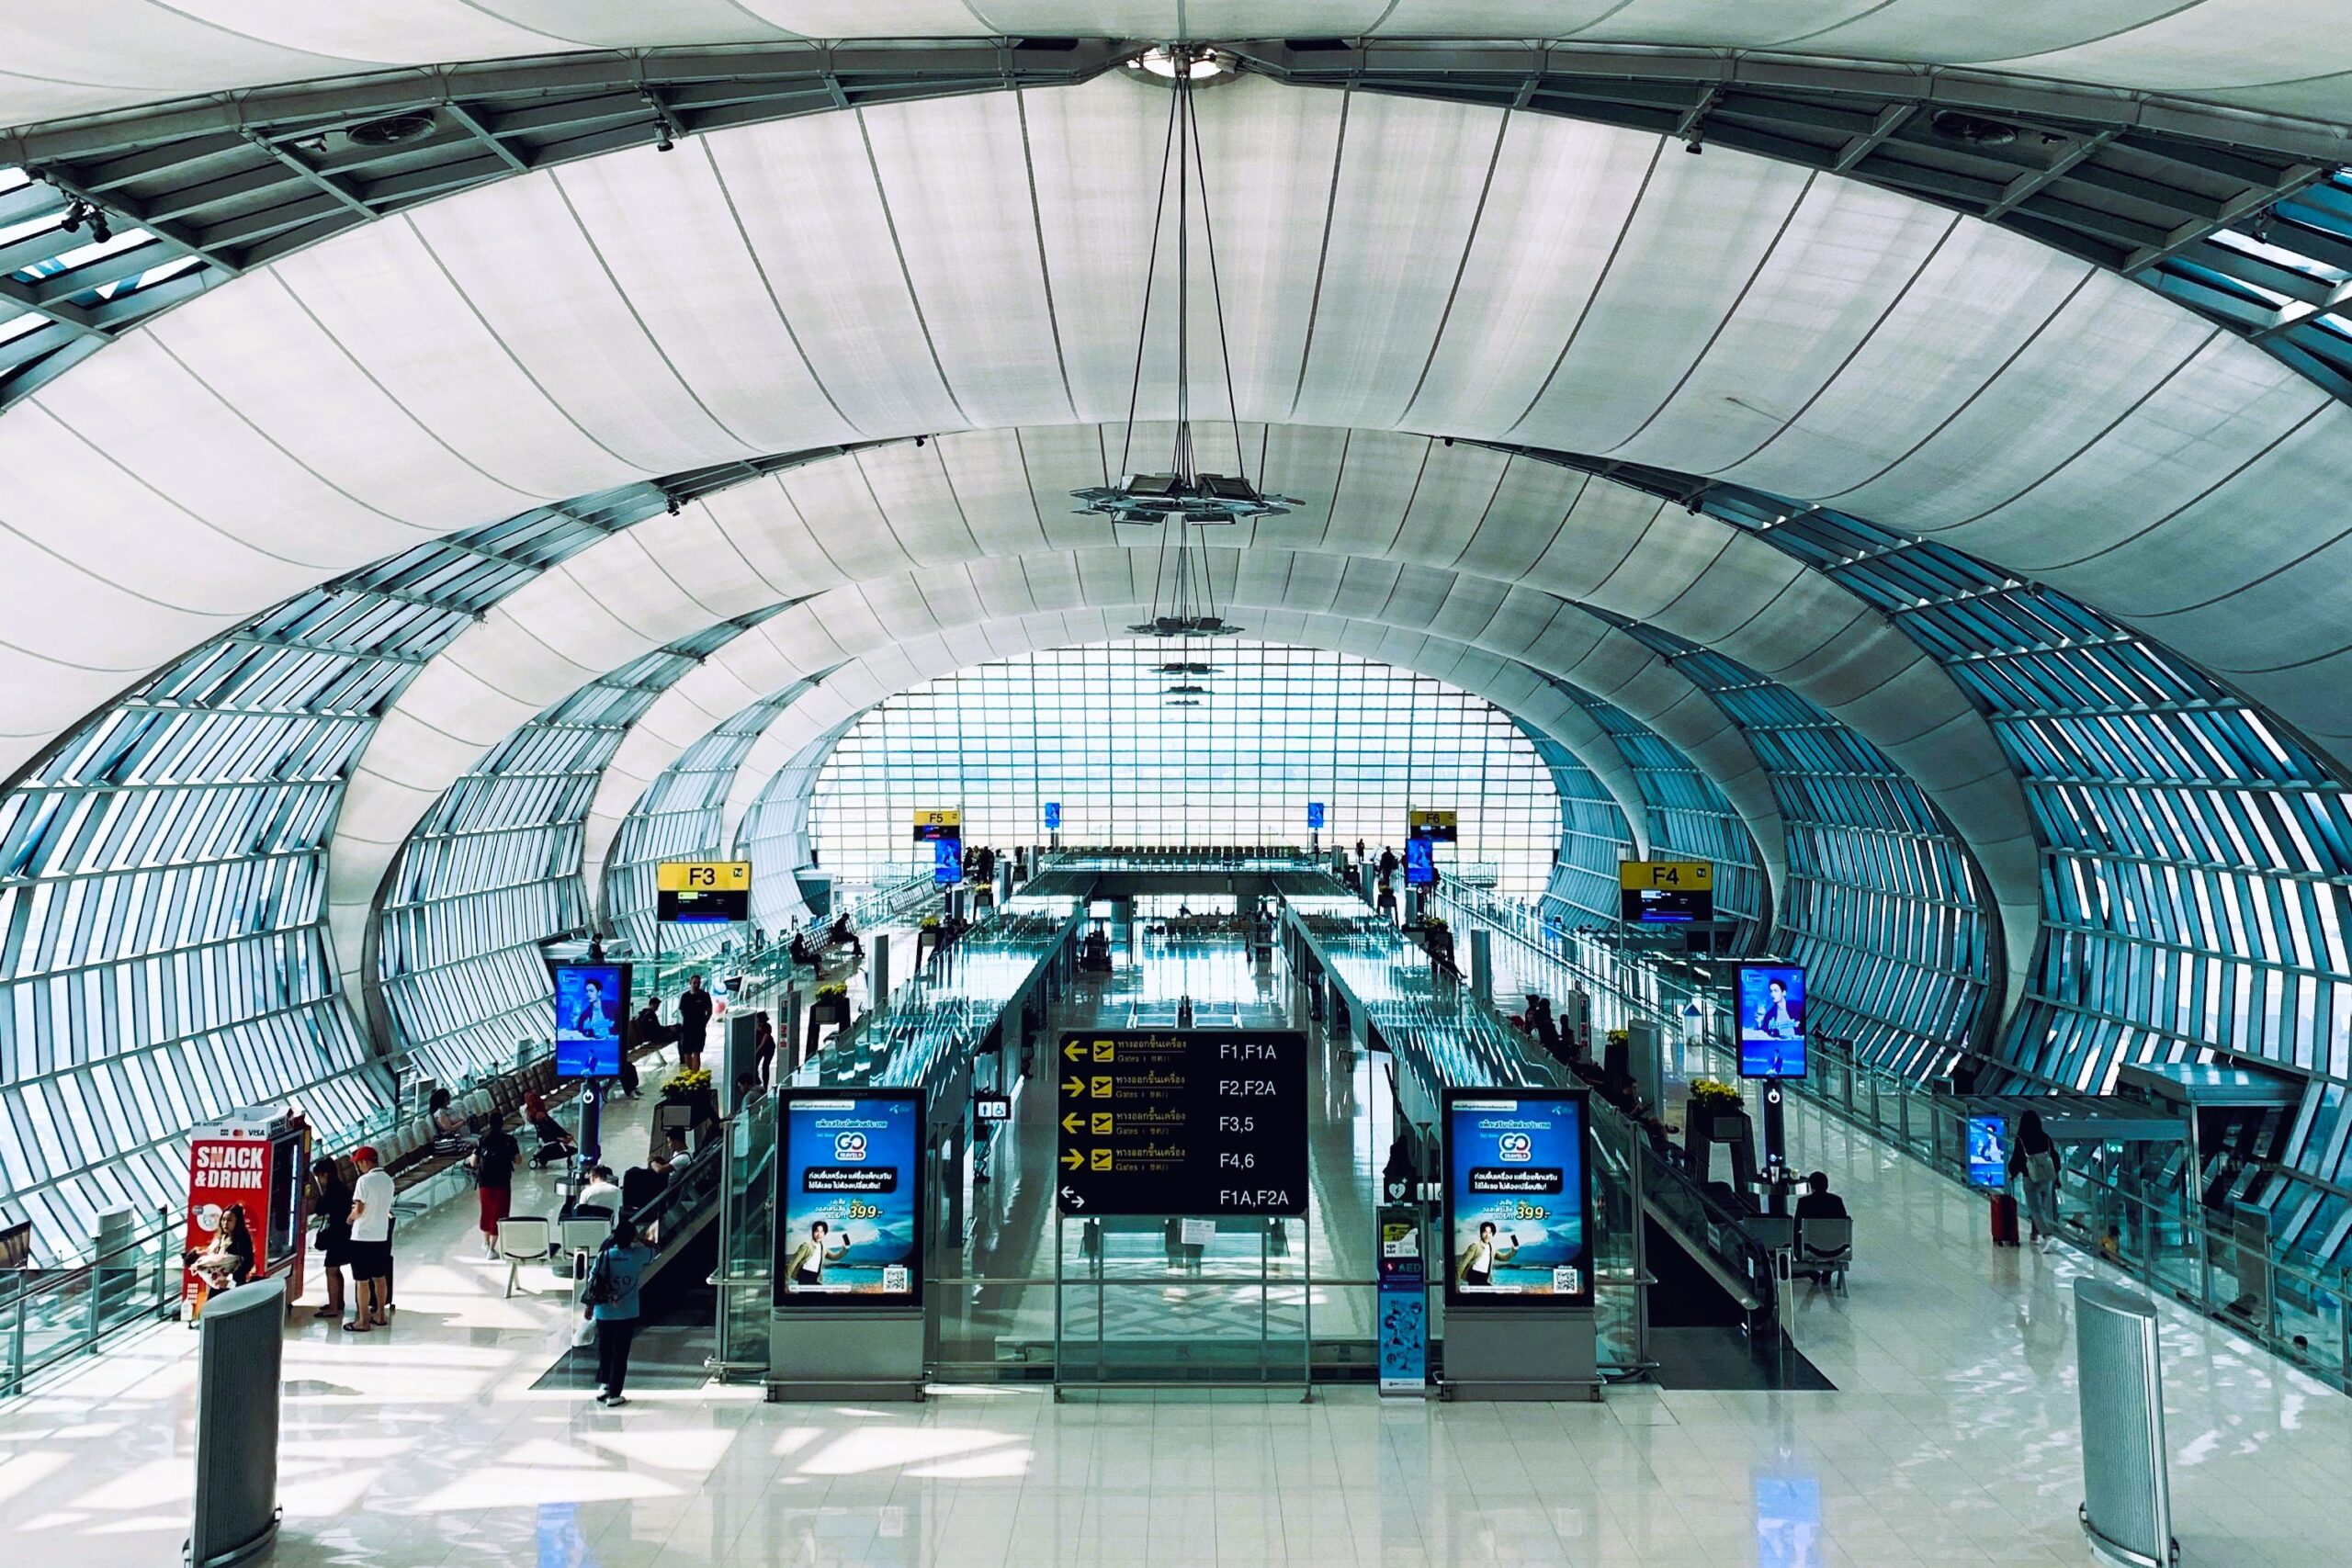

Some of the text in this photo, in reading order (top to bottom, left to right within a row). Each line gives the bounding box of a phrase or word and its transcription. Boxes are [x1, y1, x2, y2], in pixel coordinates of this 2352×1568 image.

[930, 813, 944, 823] F5
[1426, 813, 1440, 823] F6
[689, 867, 715, 886] F3
[1653, 867, 1679, 886] F4
[1117, 1055, 1139, 1063] Gates
[1220, 1044, 1277, 1061] F1,F1A
[1115, 1090, 1138, 1099] Gates
[1219, 1080, 1276, 1097] F2,F2A
[1115, 1127, 1138, 1135] Gates
[1219, 1116, 1254, 1134] F3,5
[837, 1134, 865, 1150] GO
[1501, 1134, 1529, 1151] GO
[197, 1145, 264, 1169] SNACK
[1220, 1153, 1255, 1170] F4,6
[195, 1170, 263, 1190] &DRINK
[1220, 1190, 1289, 1208] F1A,F2A
[1398, 1263, 1421, 1273] AED
